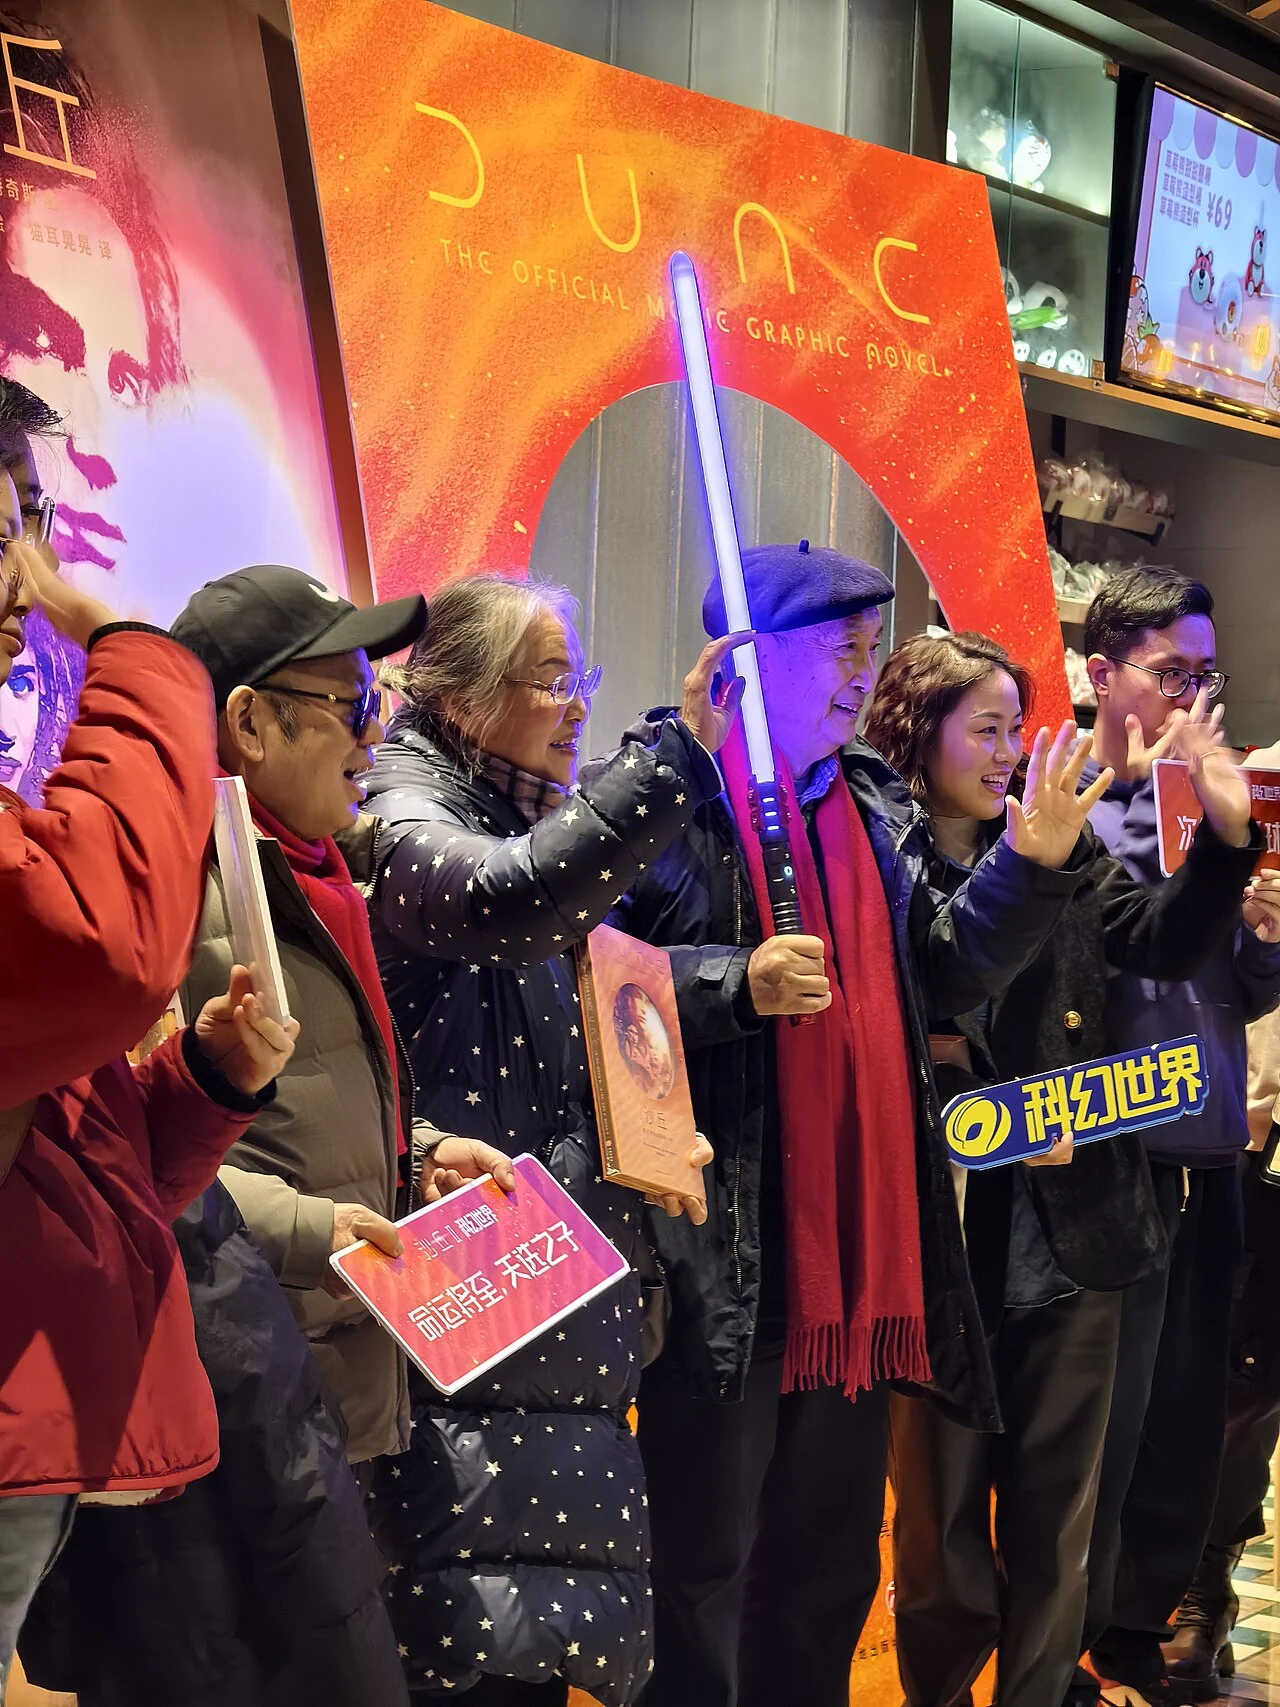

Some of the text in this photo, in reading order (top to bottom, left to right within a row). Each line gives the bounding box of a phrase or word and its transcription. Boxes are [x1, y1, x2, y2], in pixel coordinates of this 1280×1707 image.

[1207, 192, 1232, 231] ¥69
[439, 239, 942, 378] THE OFFICIAL MIE GRAPHIC NOVEL
[1021, 1043, 1203, 1144] 科幻世界
[453, 1203, 499, 1239] 科幻世界
